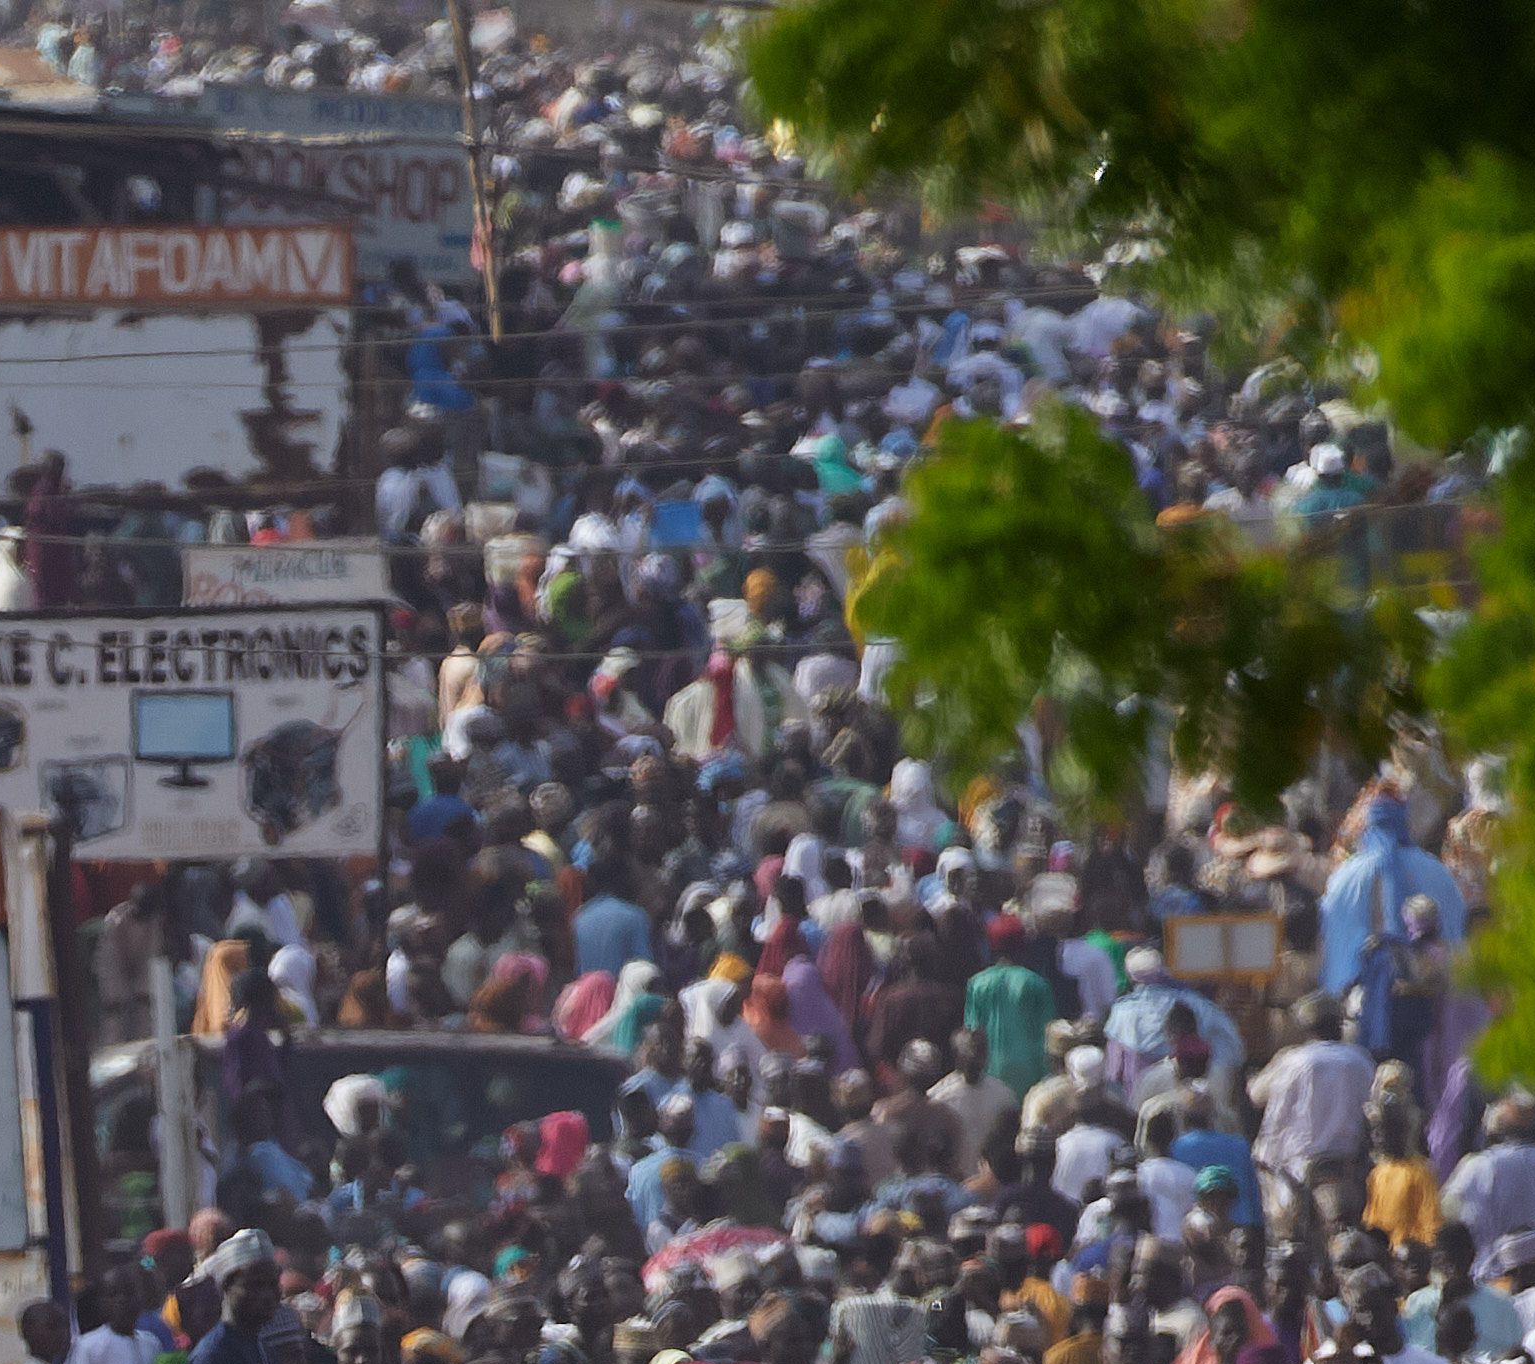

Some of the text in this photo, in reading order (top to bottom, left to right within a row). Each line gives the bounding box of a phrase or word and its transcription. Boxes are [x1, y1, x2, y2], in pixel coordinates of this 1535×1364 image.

[4, 230, 287, 295] VITAFOAM
[45, 631, 88, 686] C.
[98, 624, 371, 684] ELECTRONICS
